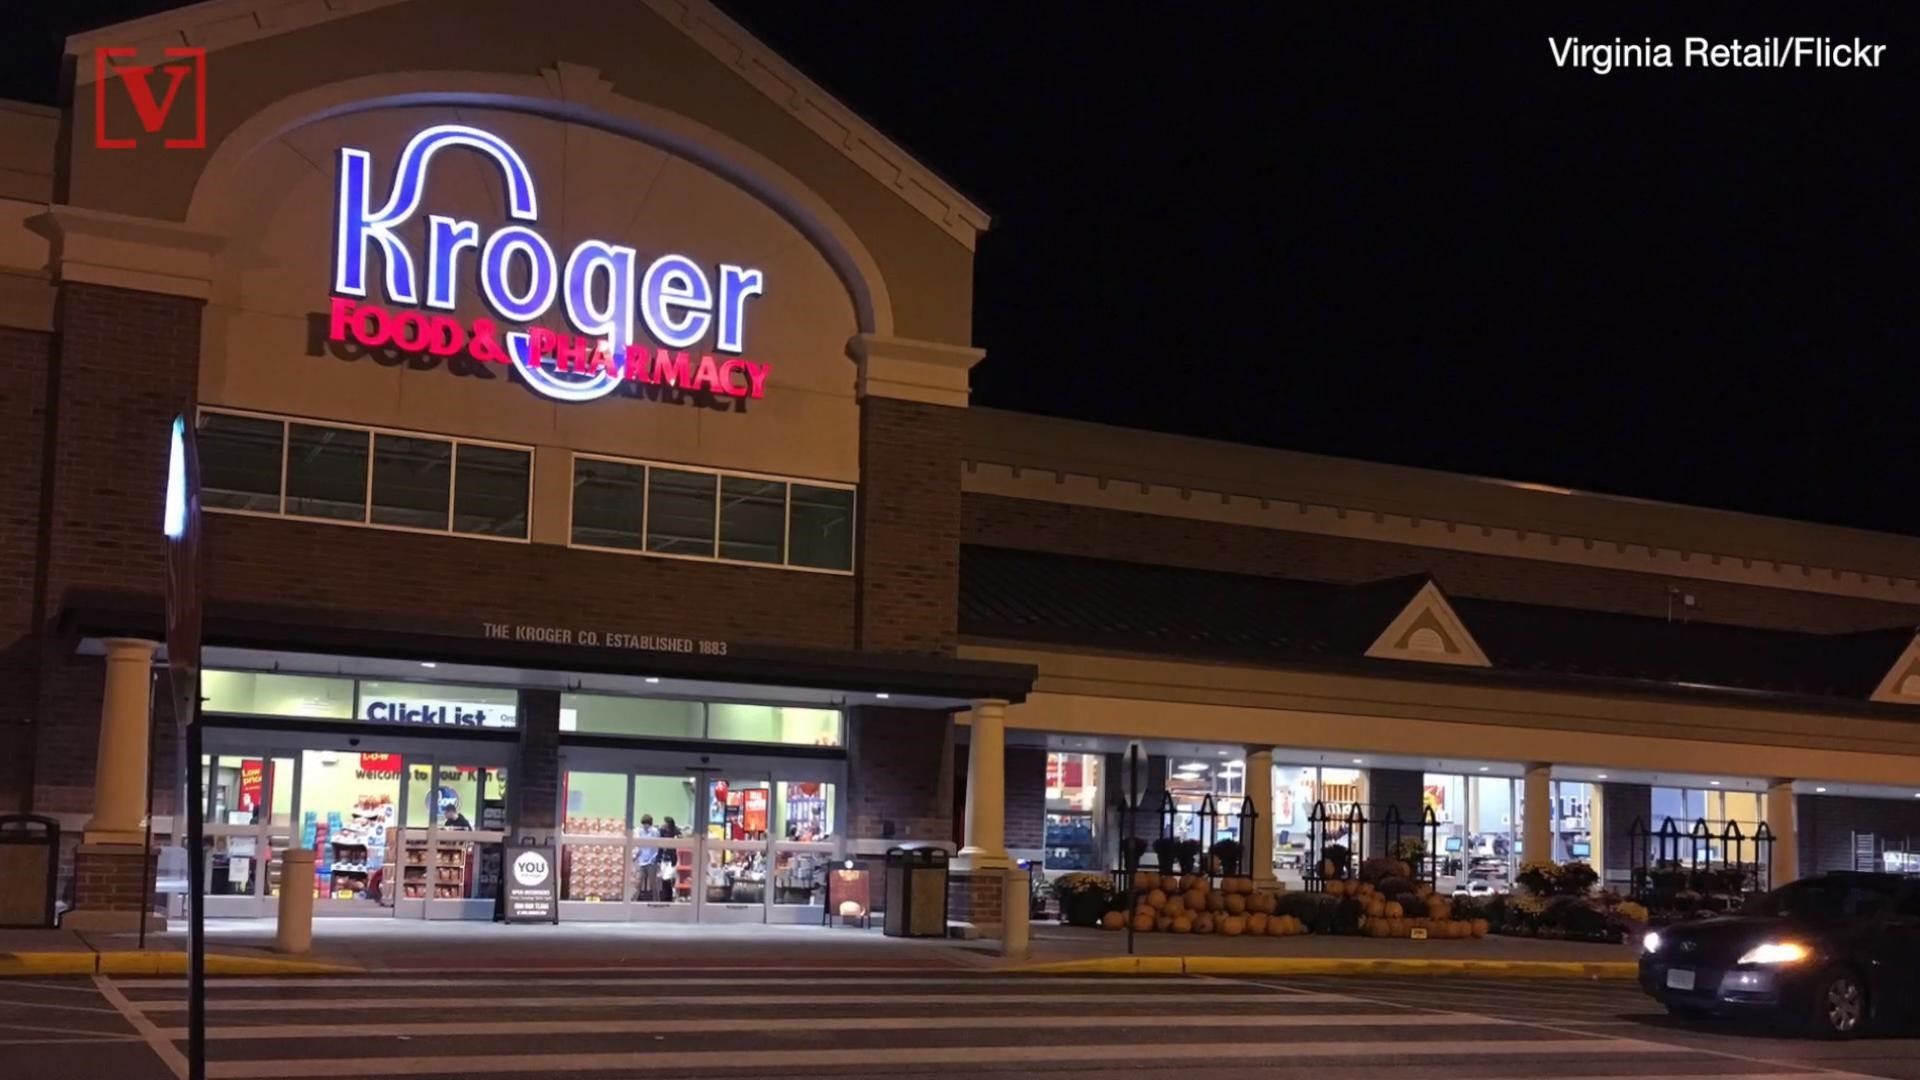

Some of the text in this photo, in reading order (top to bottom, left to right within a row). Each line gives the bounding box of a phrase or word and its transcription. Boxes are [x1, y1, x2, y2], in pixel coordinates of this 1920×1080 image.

[335, 124, 764, 402] Kroger
[526, 326, 774, 400] PHARMACY
[483, 622, 727, 656] THE KROGER CO. ESTABLISHED 1883
[366, 701, 486, 727] ClickList
[439, 770, 462, 781] our
[517, 862, 546, 873] YOU
